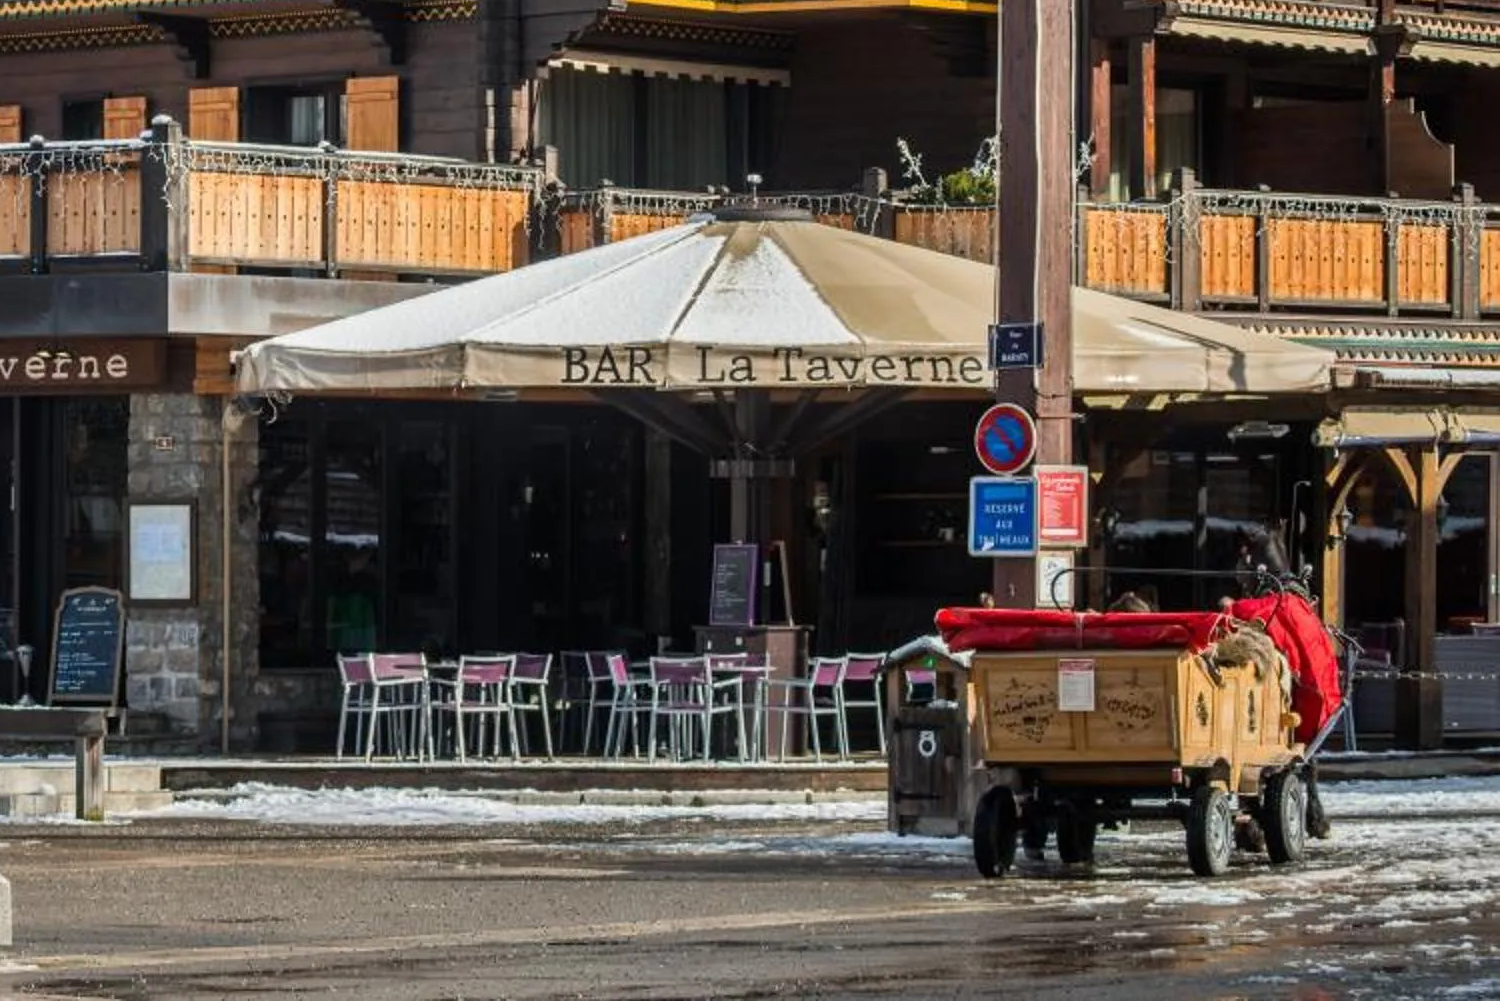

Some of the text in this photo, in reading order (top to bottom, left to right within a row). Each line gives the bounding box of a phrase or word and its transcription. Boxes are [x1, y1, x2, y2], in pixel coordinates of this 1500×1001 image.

[560, 346, 983, 384] BAR La Taverne
